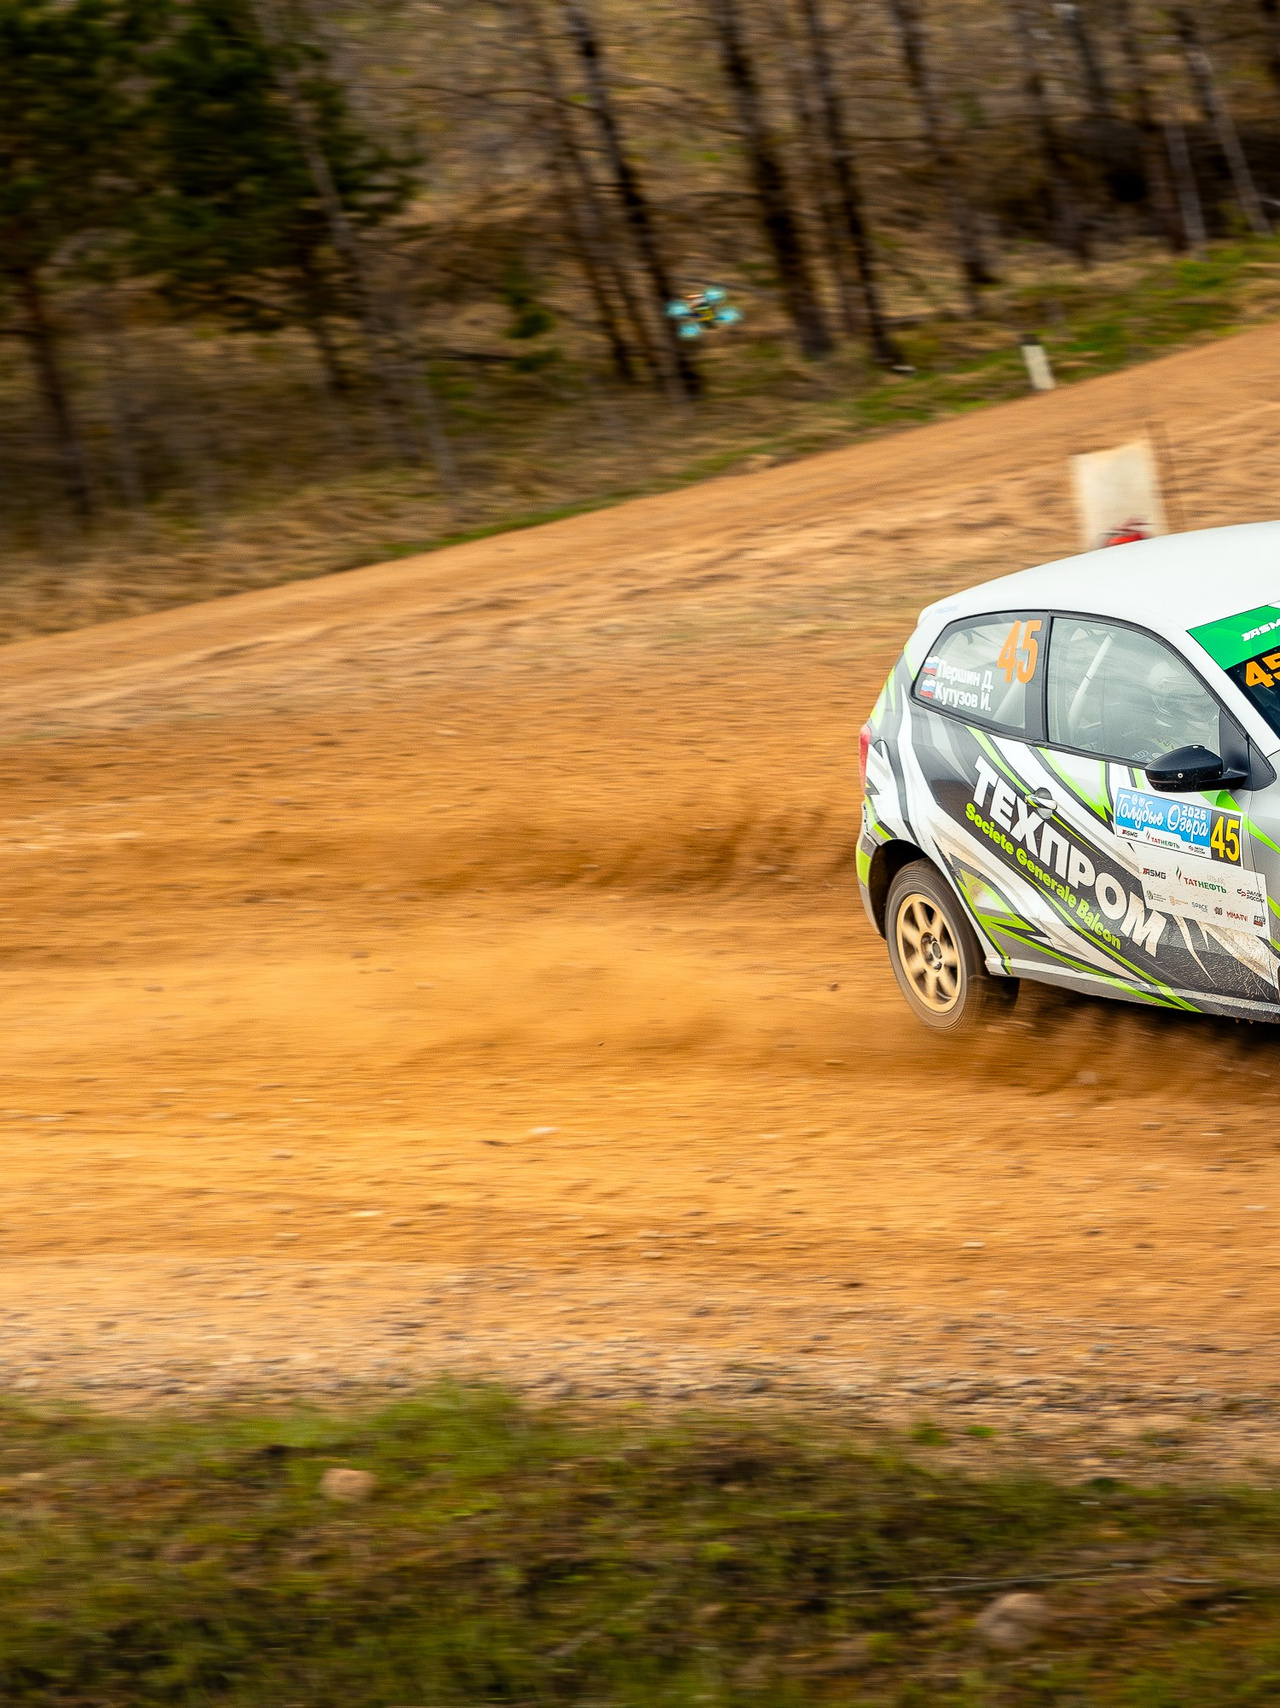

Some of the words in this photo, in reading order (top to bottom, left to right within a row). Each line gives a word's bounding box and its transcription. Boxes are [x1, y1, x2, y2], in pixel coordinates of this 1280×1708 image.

[997, 620, 1042, 684] 45
[934, 681, 978, 708] Кутузов
[1182, 805, 1207, 820] 2026
[973, 755, 1167, 957] ТЕХПРОМ
[1211, 815, 1240, 862] 45
[965, 803, 1014, 855] Societe
[1016, 848, 1076, 908] Generale
[1075, 902, 1121, 950] Balcon
[1183, 877, 1227, 893] ТАТНЕФТЬ
